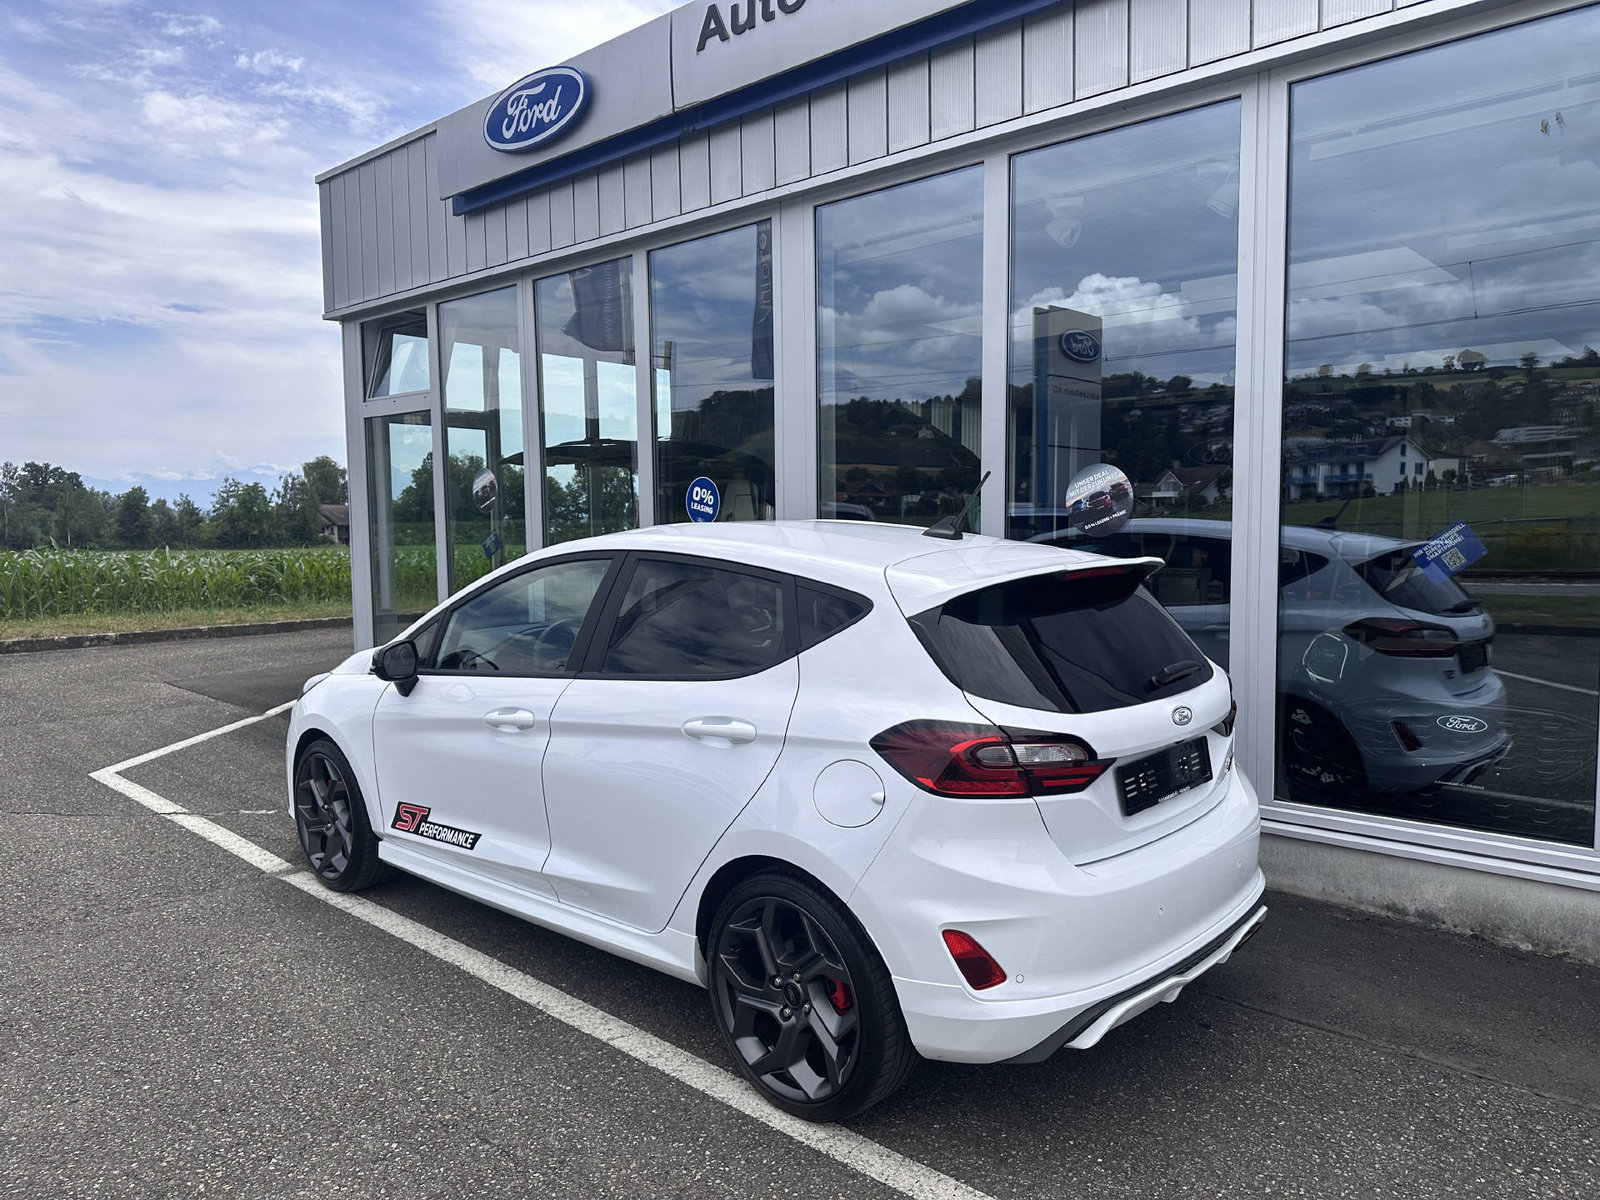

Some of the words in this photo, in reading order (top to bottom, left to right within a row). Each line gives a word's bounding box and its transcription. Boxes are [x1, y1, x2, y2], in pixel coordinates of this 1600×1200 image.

[501, 81, 562, 139] Ford
[692, 486, 714, 505] 0%
[691, 502, 714, 515] LEASING
[1446, 716, 1478, 731] Ford
[395, 804, 429, 832] ST
[418, 822, 475, 848] PERFORMANCE
